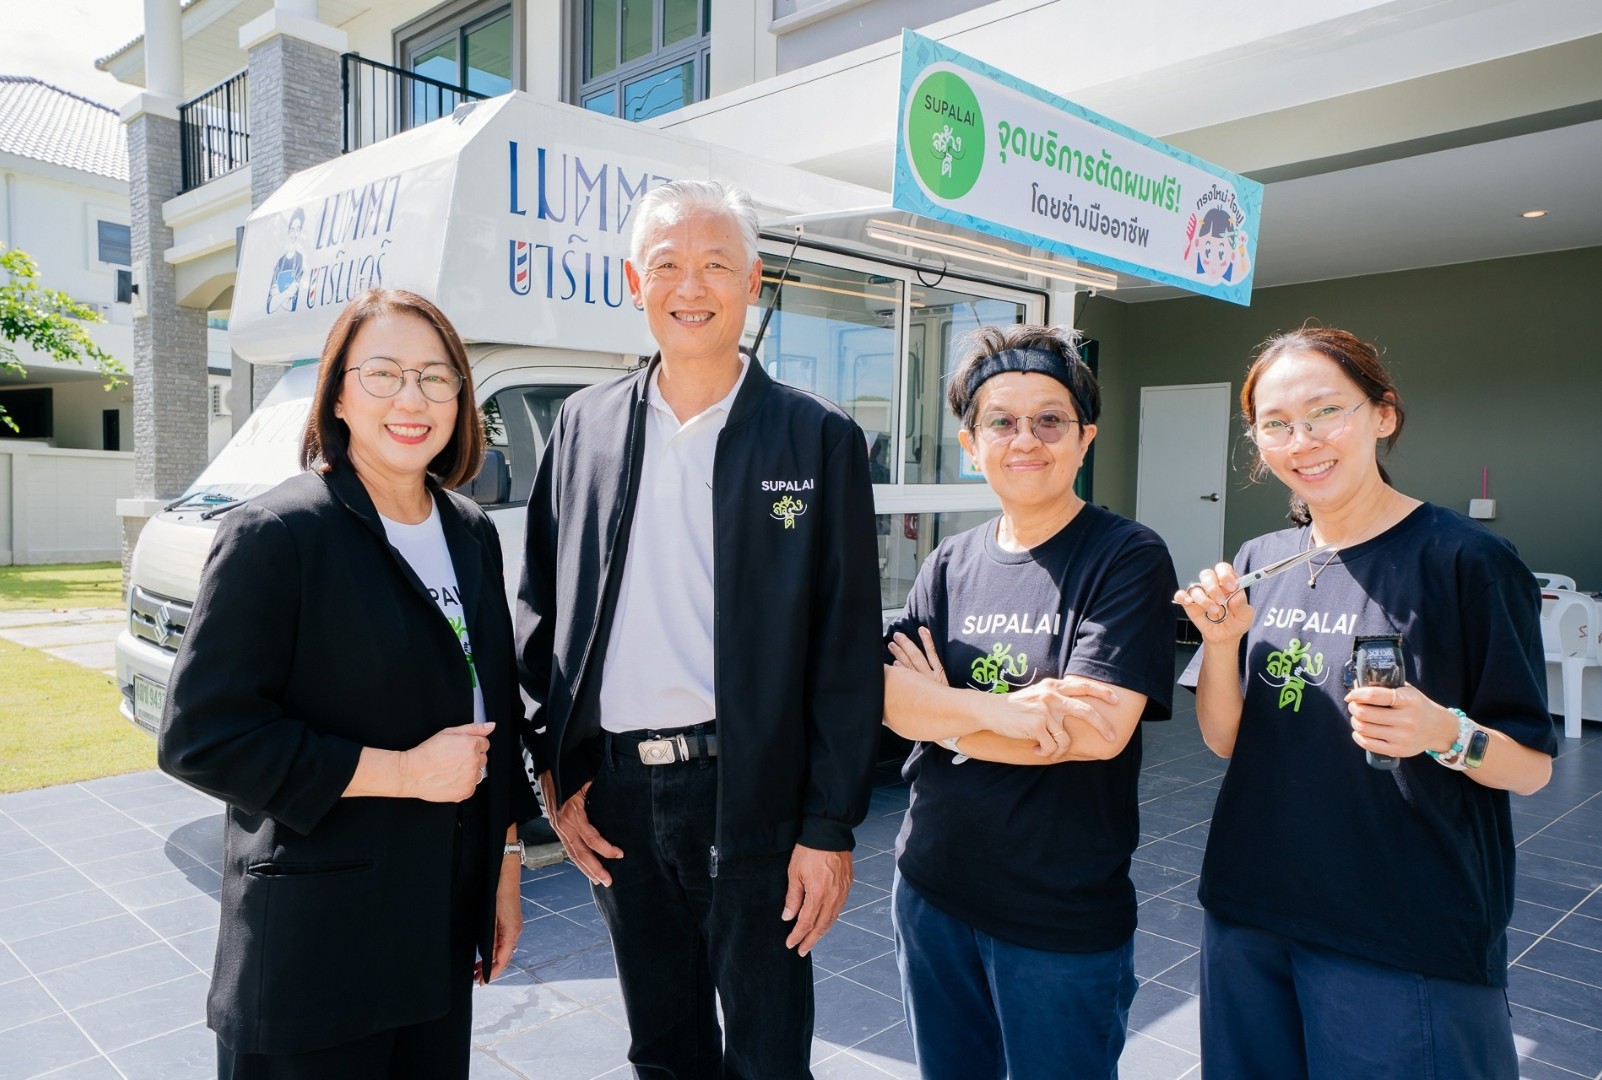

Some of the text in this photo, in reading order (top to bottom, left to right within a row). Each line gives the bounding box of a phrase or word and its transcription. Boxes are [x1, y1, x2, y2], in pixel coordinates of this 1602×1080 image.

[924, 94, 975, 127] SUPALAI
[998, 121, 1181, 213] จุดบริการตัดผมฟรี!
[1031, 182, 1149, 248] โดยช่างมืออาชีพ
[761, 478, 815, 492] SUPALAI
[961, 613, 1061, 636] SUPALAI
[1264, 607, 1358, 635] SUPALAI
